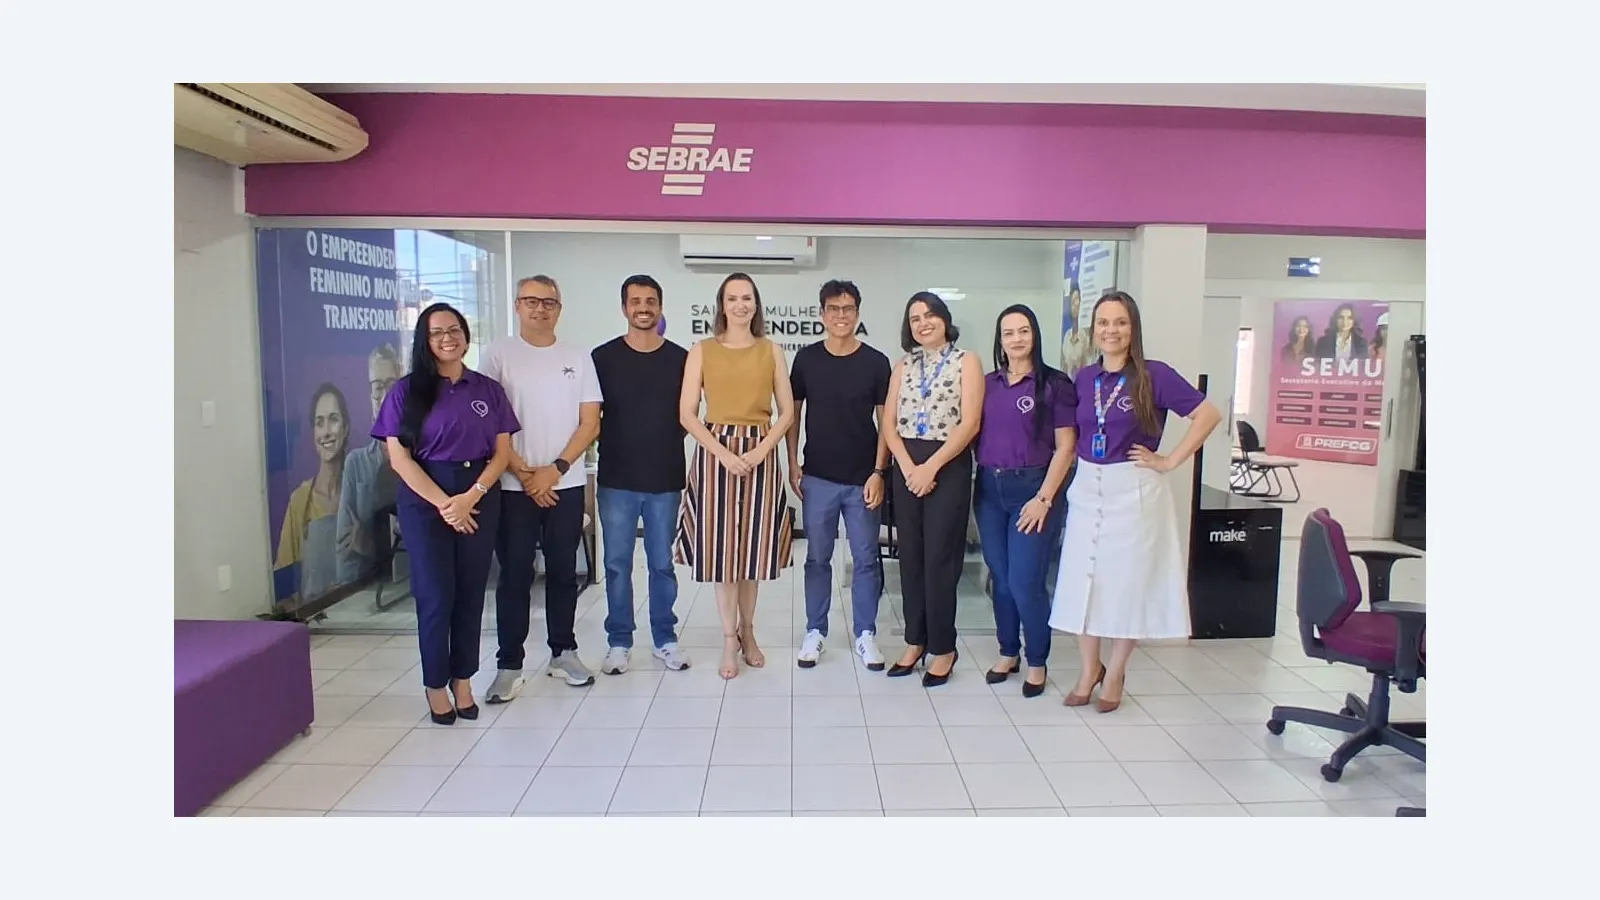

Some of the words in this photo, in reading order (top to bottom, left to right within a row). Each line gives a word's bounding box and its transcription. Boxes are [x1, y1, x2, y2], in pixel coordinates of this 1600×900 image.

[626, 146, 754, 172] SEBRAE
[306, 230, 318, 257] O
[321, 233, 396, 269] EMPREENDED
[309, 266, 371, 298] FEMININO
[1301, 357, 1382, 378] SEMU
[1314, 437, 1370, 452] PREFCG
[1209, 529, 1247, 542] make
